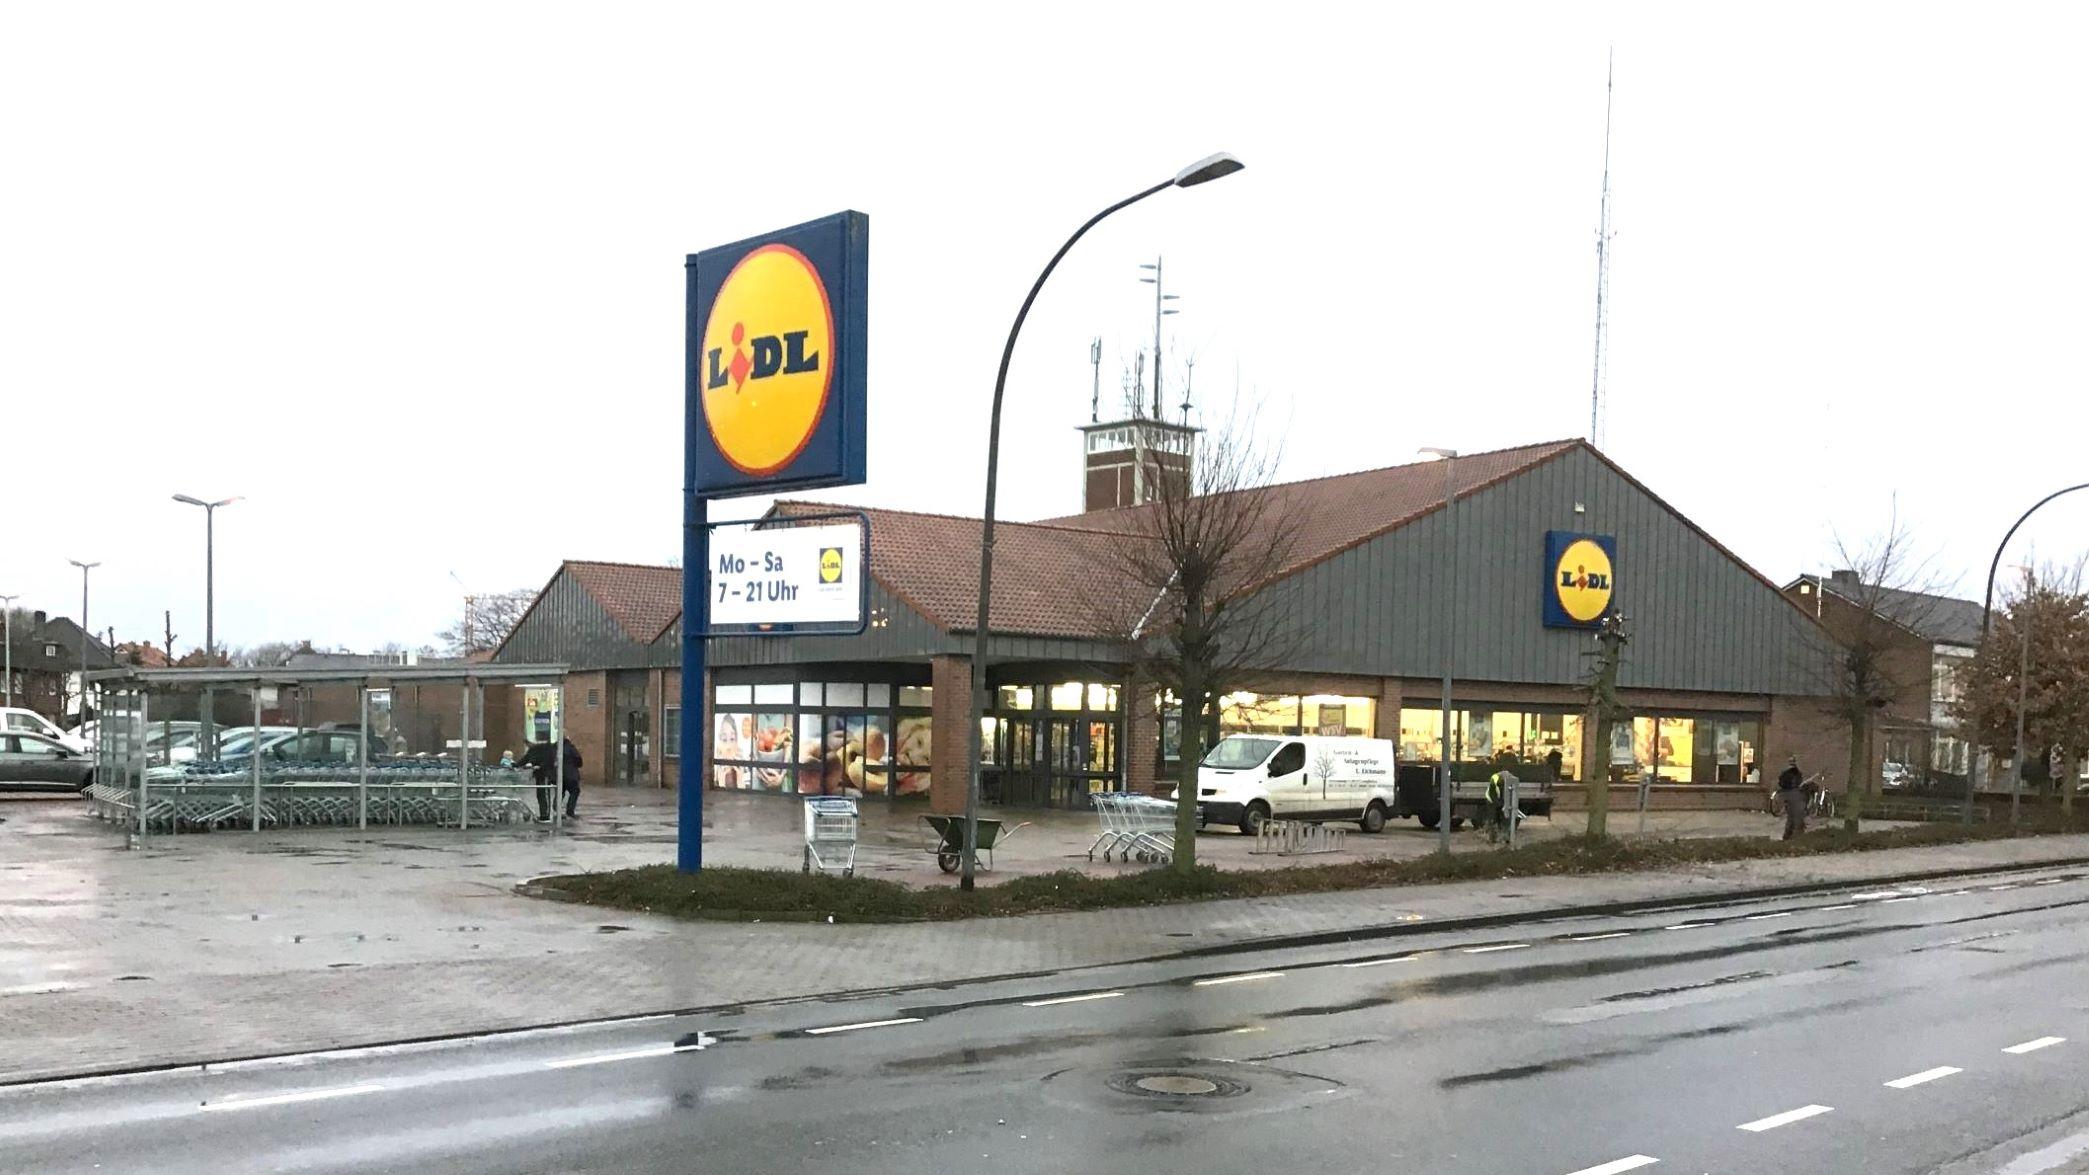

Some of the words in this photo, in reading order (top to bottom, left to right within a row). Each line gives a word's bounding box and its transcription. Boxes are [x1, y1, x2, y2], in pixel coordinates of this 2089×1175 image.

[719, 553, 745, 574] Mo
[764, 551, 783, 572] Sa
[718, 582, 727, 603] 7
[746, 581, 762, 602] 21
[768, 580, 798, 601] Uhr
